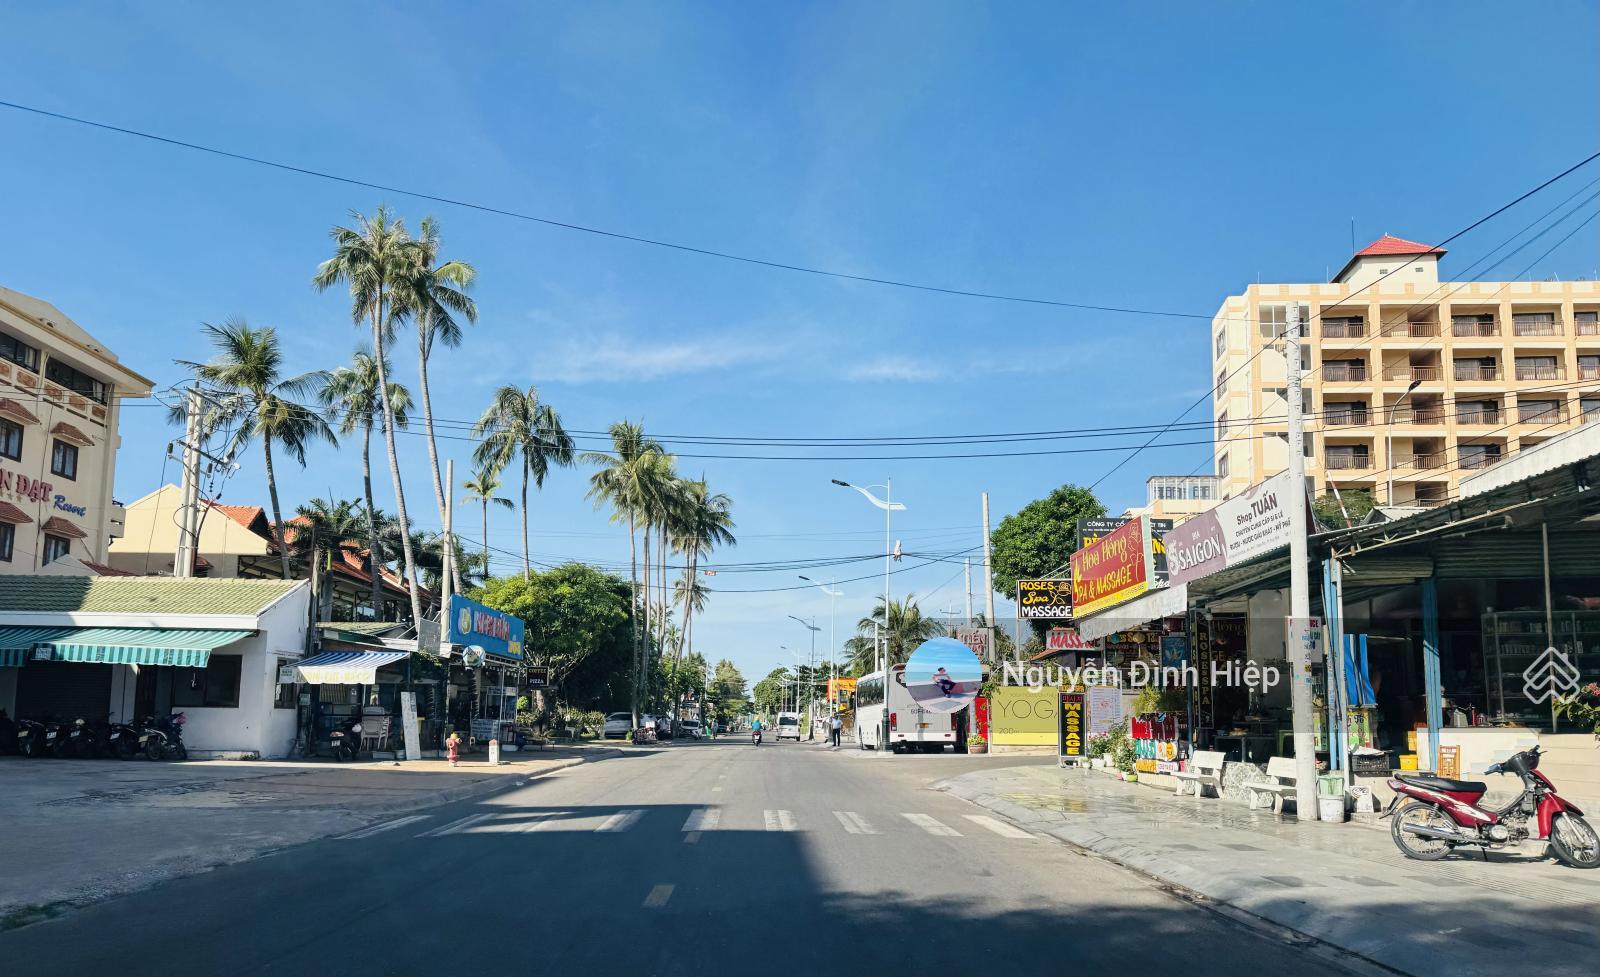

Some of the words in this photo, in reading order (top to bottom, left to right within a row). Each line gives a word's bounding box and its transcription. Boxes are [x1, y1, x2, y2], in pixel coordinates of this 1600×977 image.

[16, 474, 53, 502] ĐẠT
[54, 495, 87, 517] Resort
[1236, 511, 1253, 526] Shop
[1250, 490, 1278, 518] TUẤN
[1082, 551, 1099, 572] Hoa
[1178, 534, 1222, 571] SAIGON
[1020, 581, 1054, 591] ROSES
[1088, 581, 1095, 600] &
[1095, 564, 1132, 596] MASSAGE
[1022, 591, 1048, 605] Spa
[1021, 605, 1072, 617] MASSAGE
[997, 699, 1057, 719] YOG
[1064, 702, 1081, 756] MASSAGE
